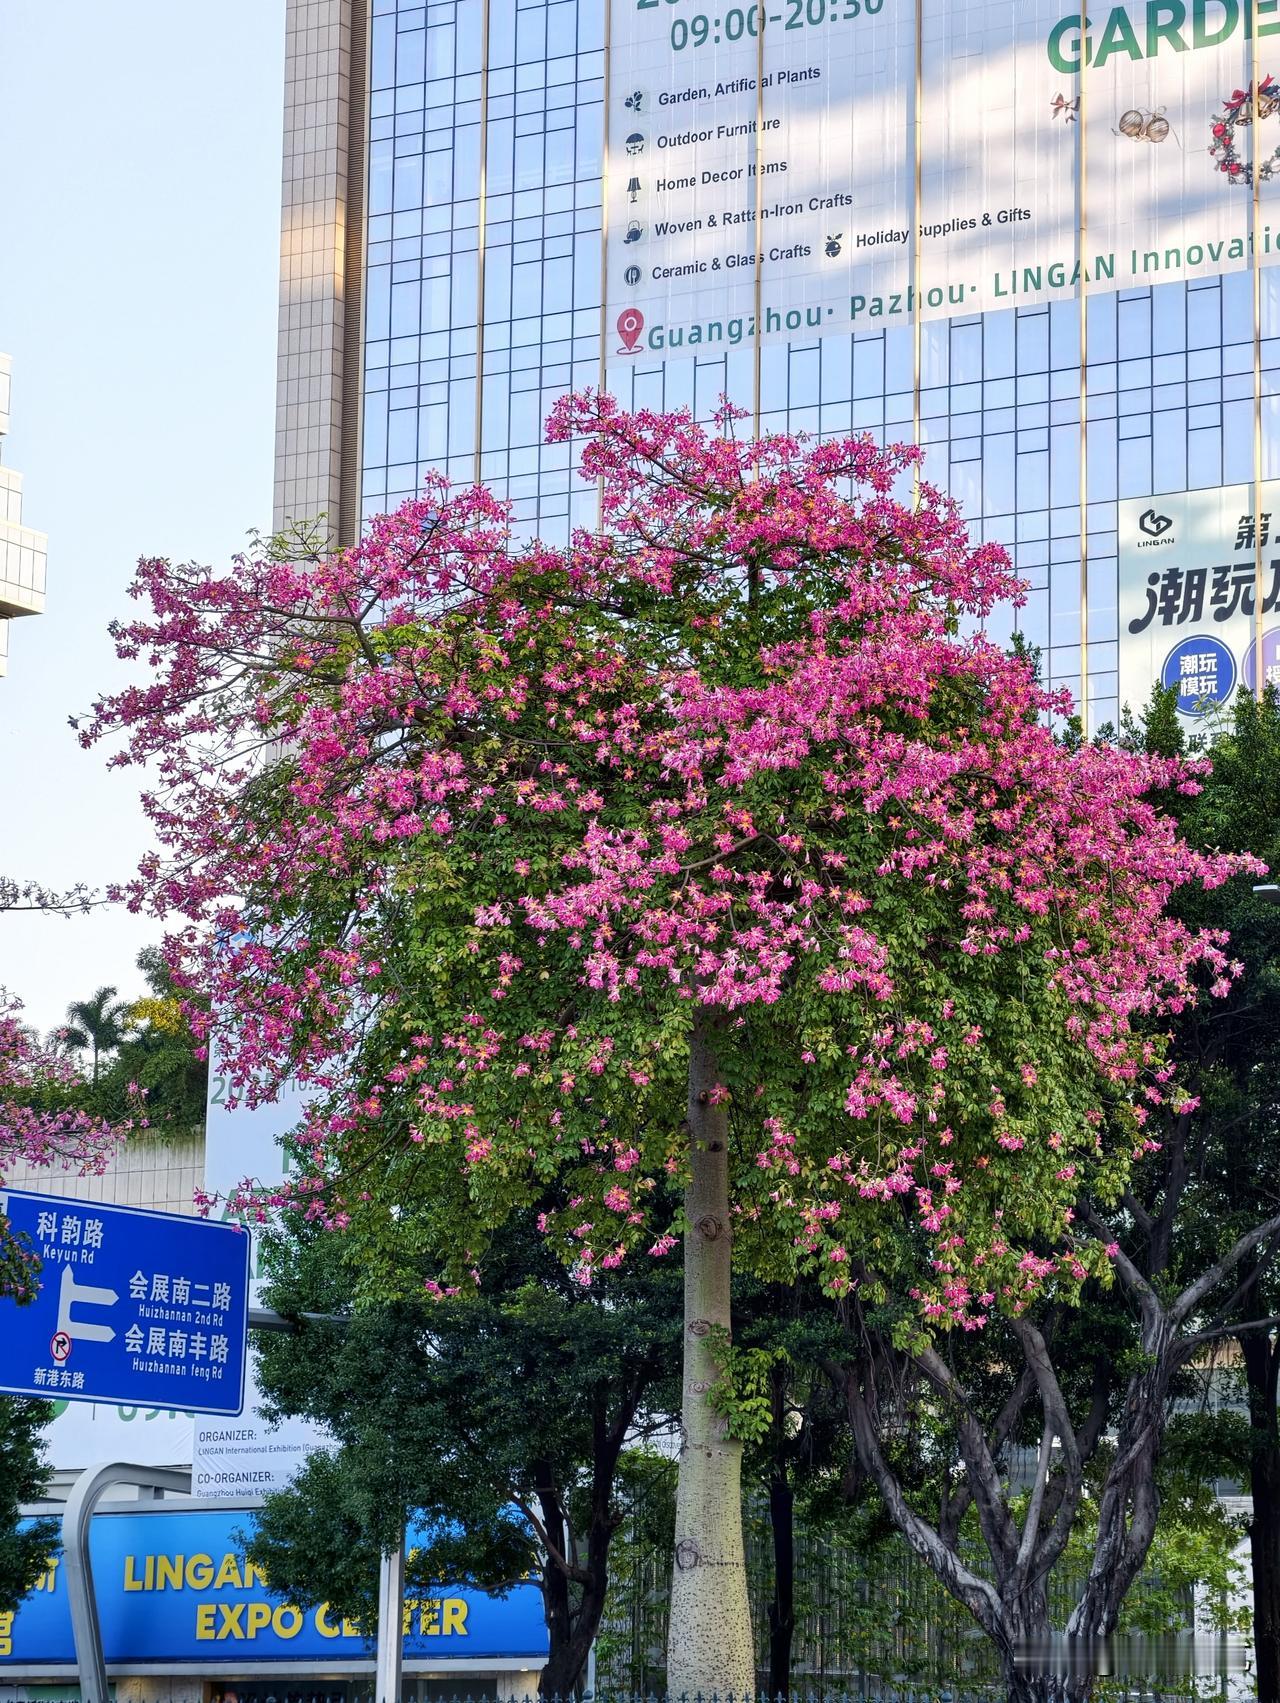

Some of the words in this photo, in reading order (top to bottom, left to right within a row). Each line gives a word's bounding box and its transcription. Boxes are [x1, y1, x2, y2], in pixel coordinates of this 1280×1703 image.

[658, 87, 711, 106] Garden,
[714, 73, 773, 97] Artifical
[777, 67, 821, 85] Plants
[657, 130, 713, 149] Outdoor
[656, 176, 697, 192] Home
[701, 168, 743, 185] Decor
[748, 161, 788, 177] Items
[655, 219, 702, 236] Woven
[707, 214, 717, 228] &
[723, 203, 803, 226] Rattan-Iron
[808, 193, 853, 211] Crafts
[856, 230, 909, 248] Holiday
[981, 212, 992, 226] &
[997, 208, 1031, 224] Gifts
[652, 261, 707, 279] Ceramic
[711, 257, 721, 271] &
[725, 251, 764, 269] Glass
[769, 244, 811, 261] Crafts
[994, 253, 1115, 297] LINGAN
[1137, 537, 1175, 548] LINGAN
[1179, 652, 1218, 675] 潮玩
[1180, 676, 1218, 697] 模玩
[36, 1211, 104, 1249] 科韵路
[43, 1244, 78, 1264] Keyun
[80, 1249, 94, 1264] Rd
[129, 1270, 231, 1311] 会展南二路
[139, 1303, 192, 1323] Huizhannan
[195, 1311, 211, 1326] 2nd
[212, 1313, 224, 1327] Rd
[124, 1323, 230, 1364] 会展南丰路
[33, 1367, 85, 1389] 新港东路
[132, 1357, 187, 1376] Huizhannan
[211, 1366, 223, 1380] Rd
[199, 1429, 257, 1442] ORGANIZER:
[225, 1445, 268, 1455] International
[268, 1443, 301, 1453] Exhibition
[197, 1471, 275, 1484] CO-ORGANIZER:
[123, 1554, 270, 1592] LINGAN
[196, 1601, 303, 1641] EXPO
